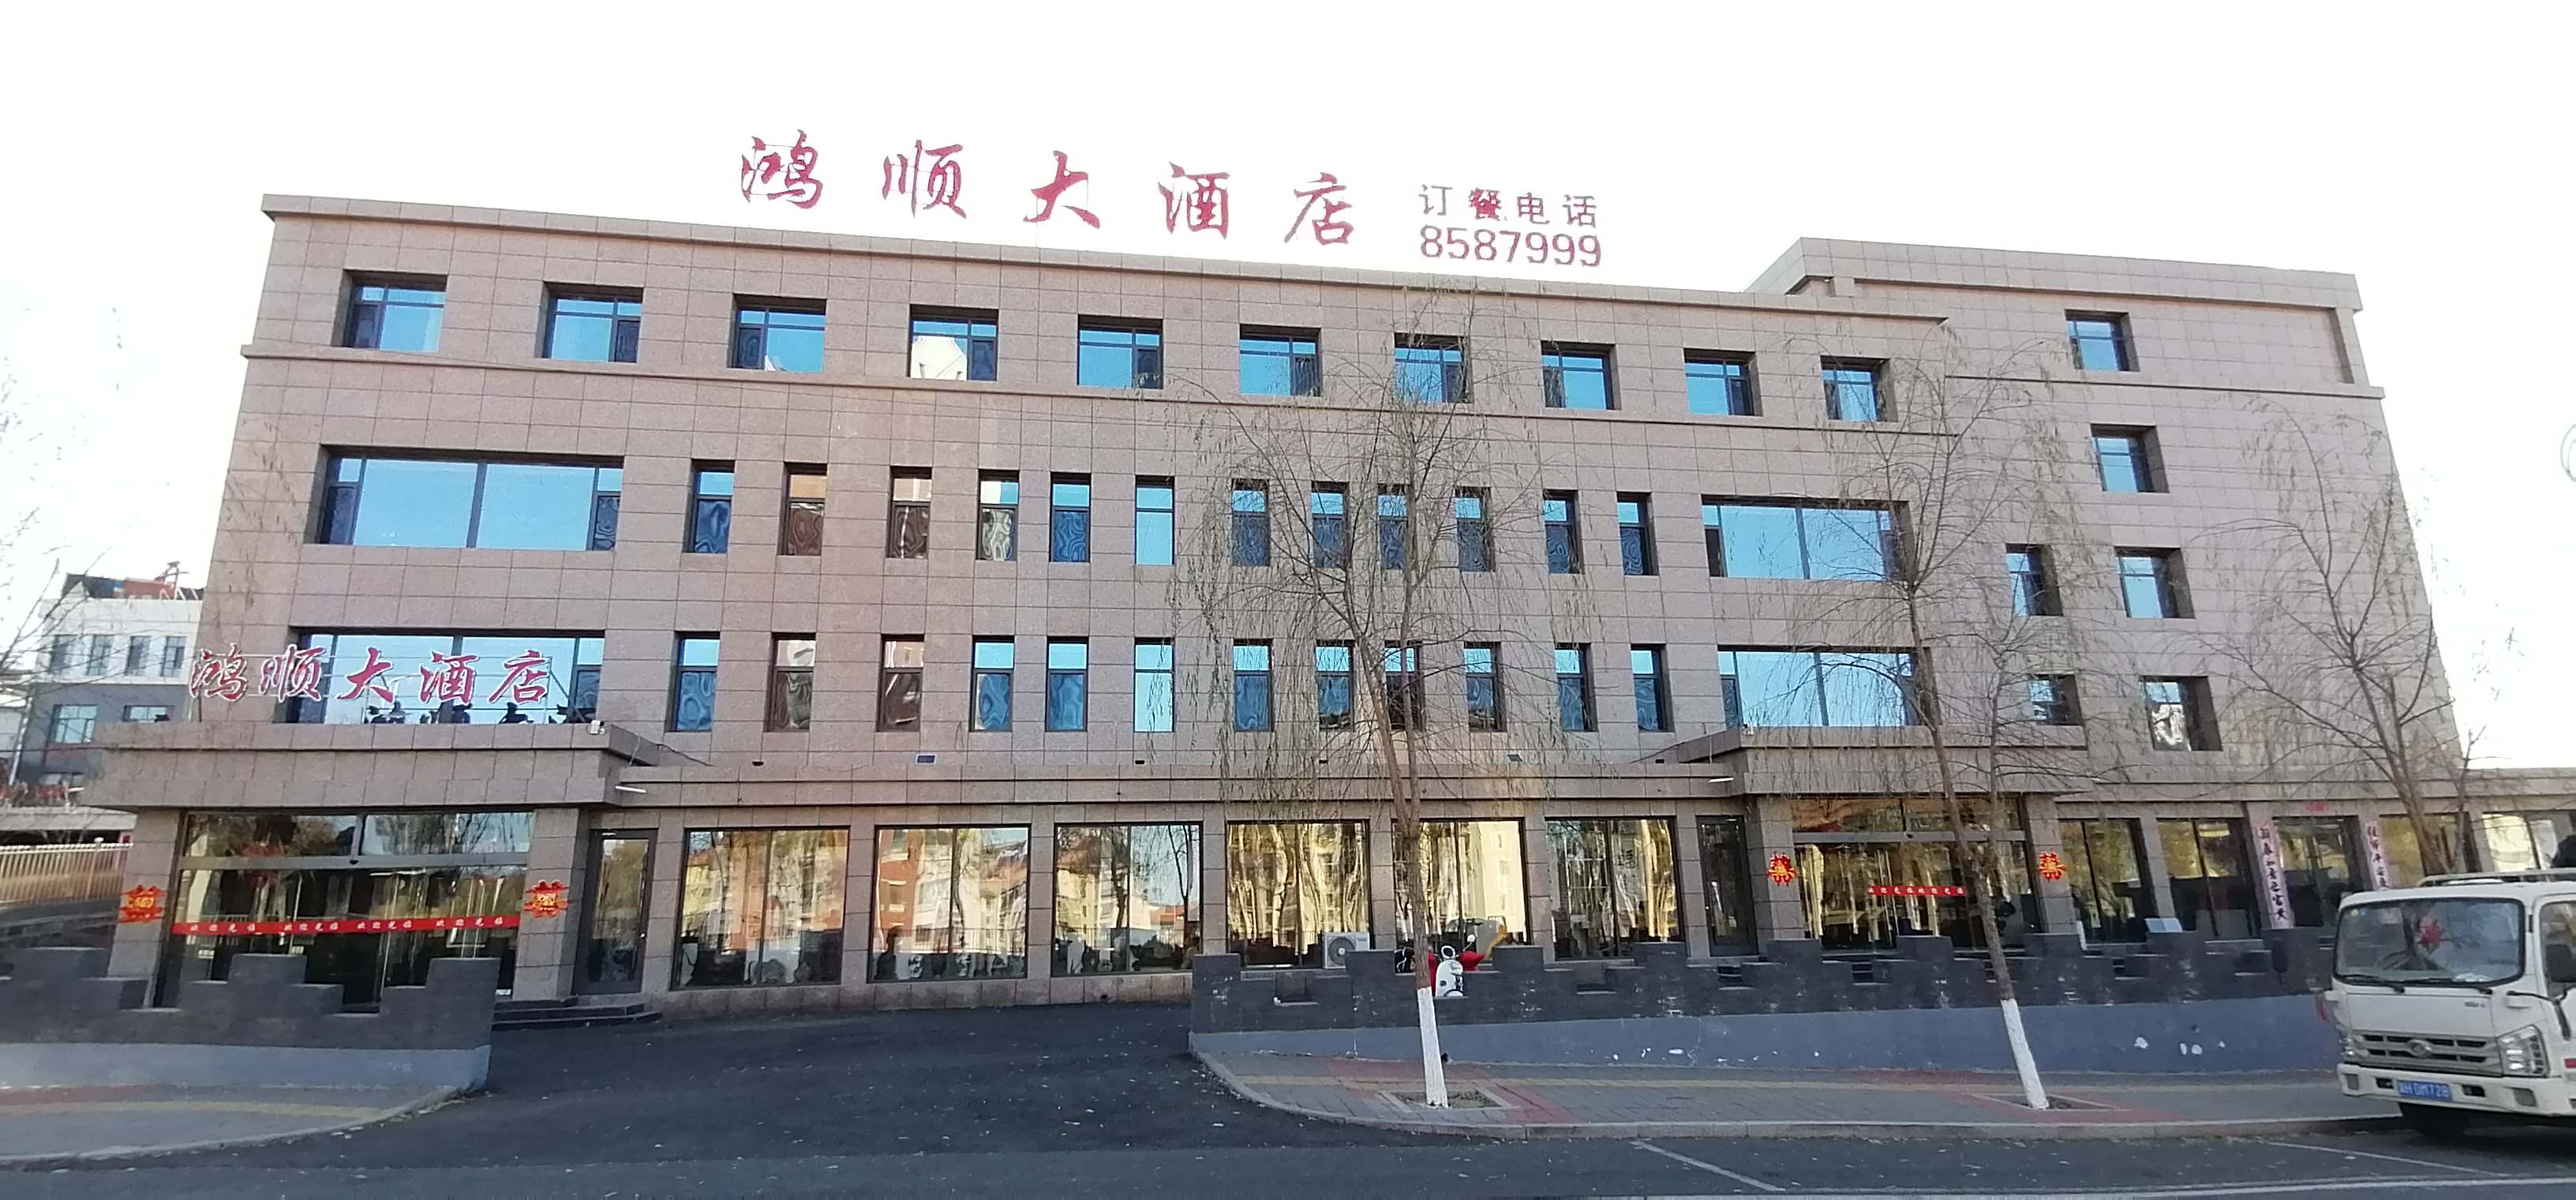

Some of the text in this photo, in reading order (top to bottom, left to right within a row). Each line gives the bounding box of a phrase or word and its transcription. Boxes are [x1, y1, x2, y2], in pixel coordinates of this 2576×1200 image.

[741, 130, 1355, 246] 鸿顺大酒店
[1418, 184, 1597, 228] 订餐电话
[1420, 224, 1601, 267] 8587999
[189, 643, 552, 705] 鸿顺大酒店
